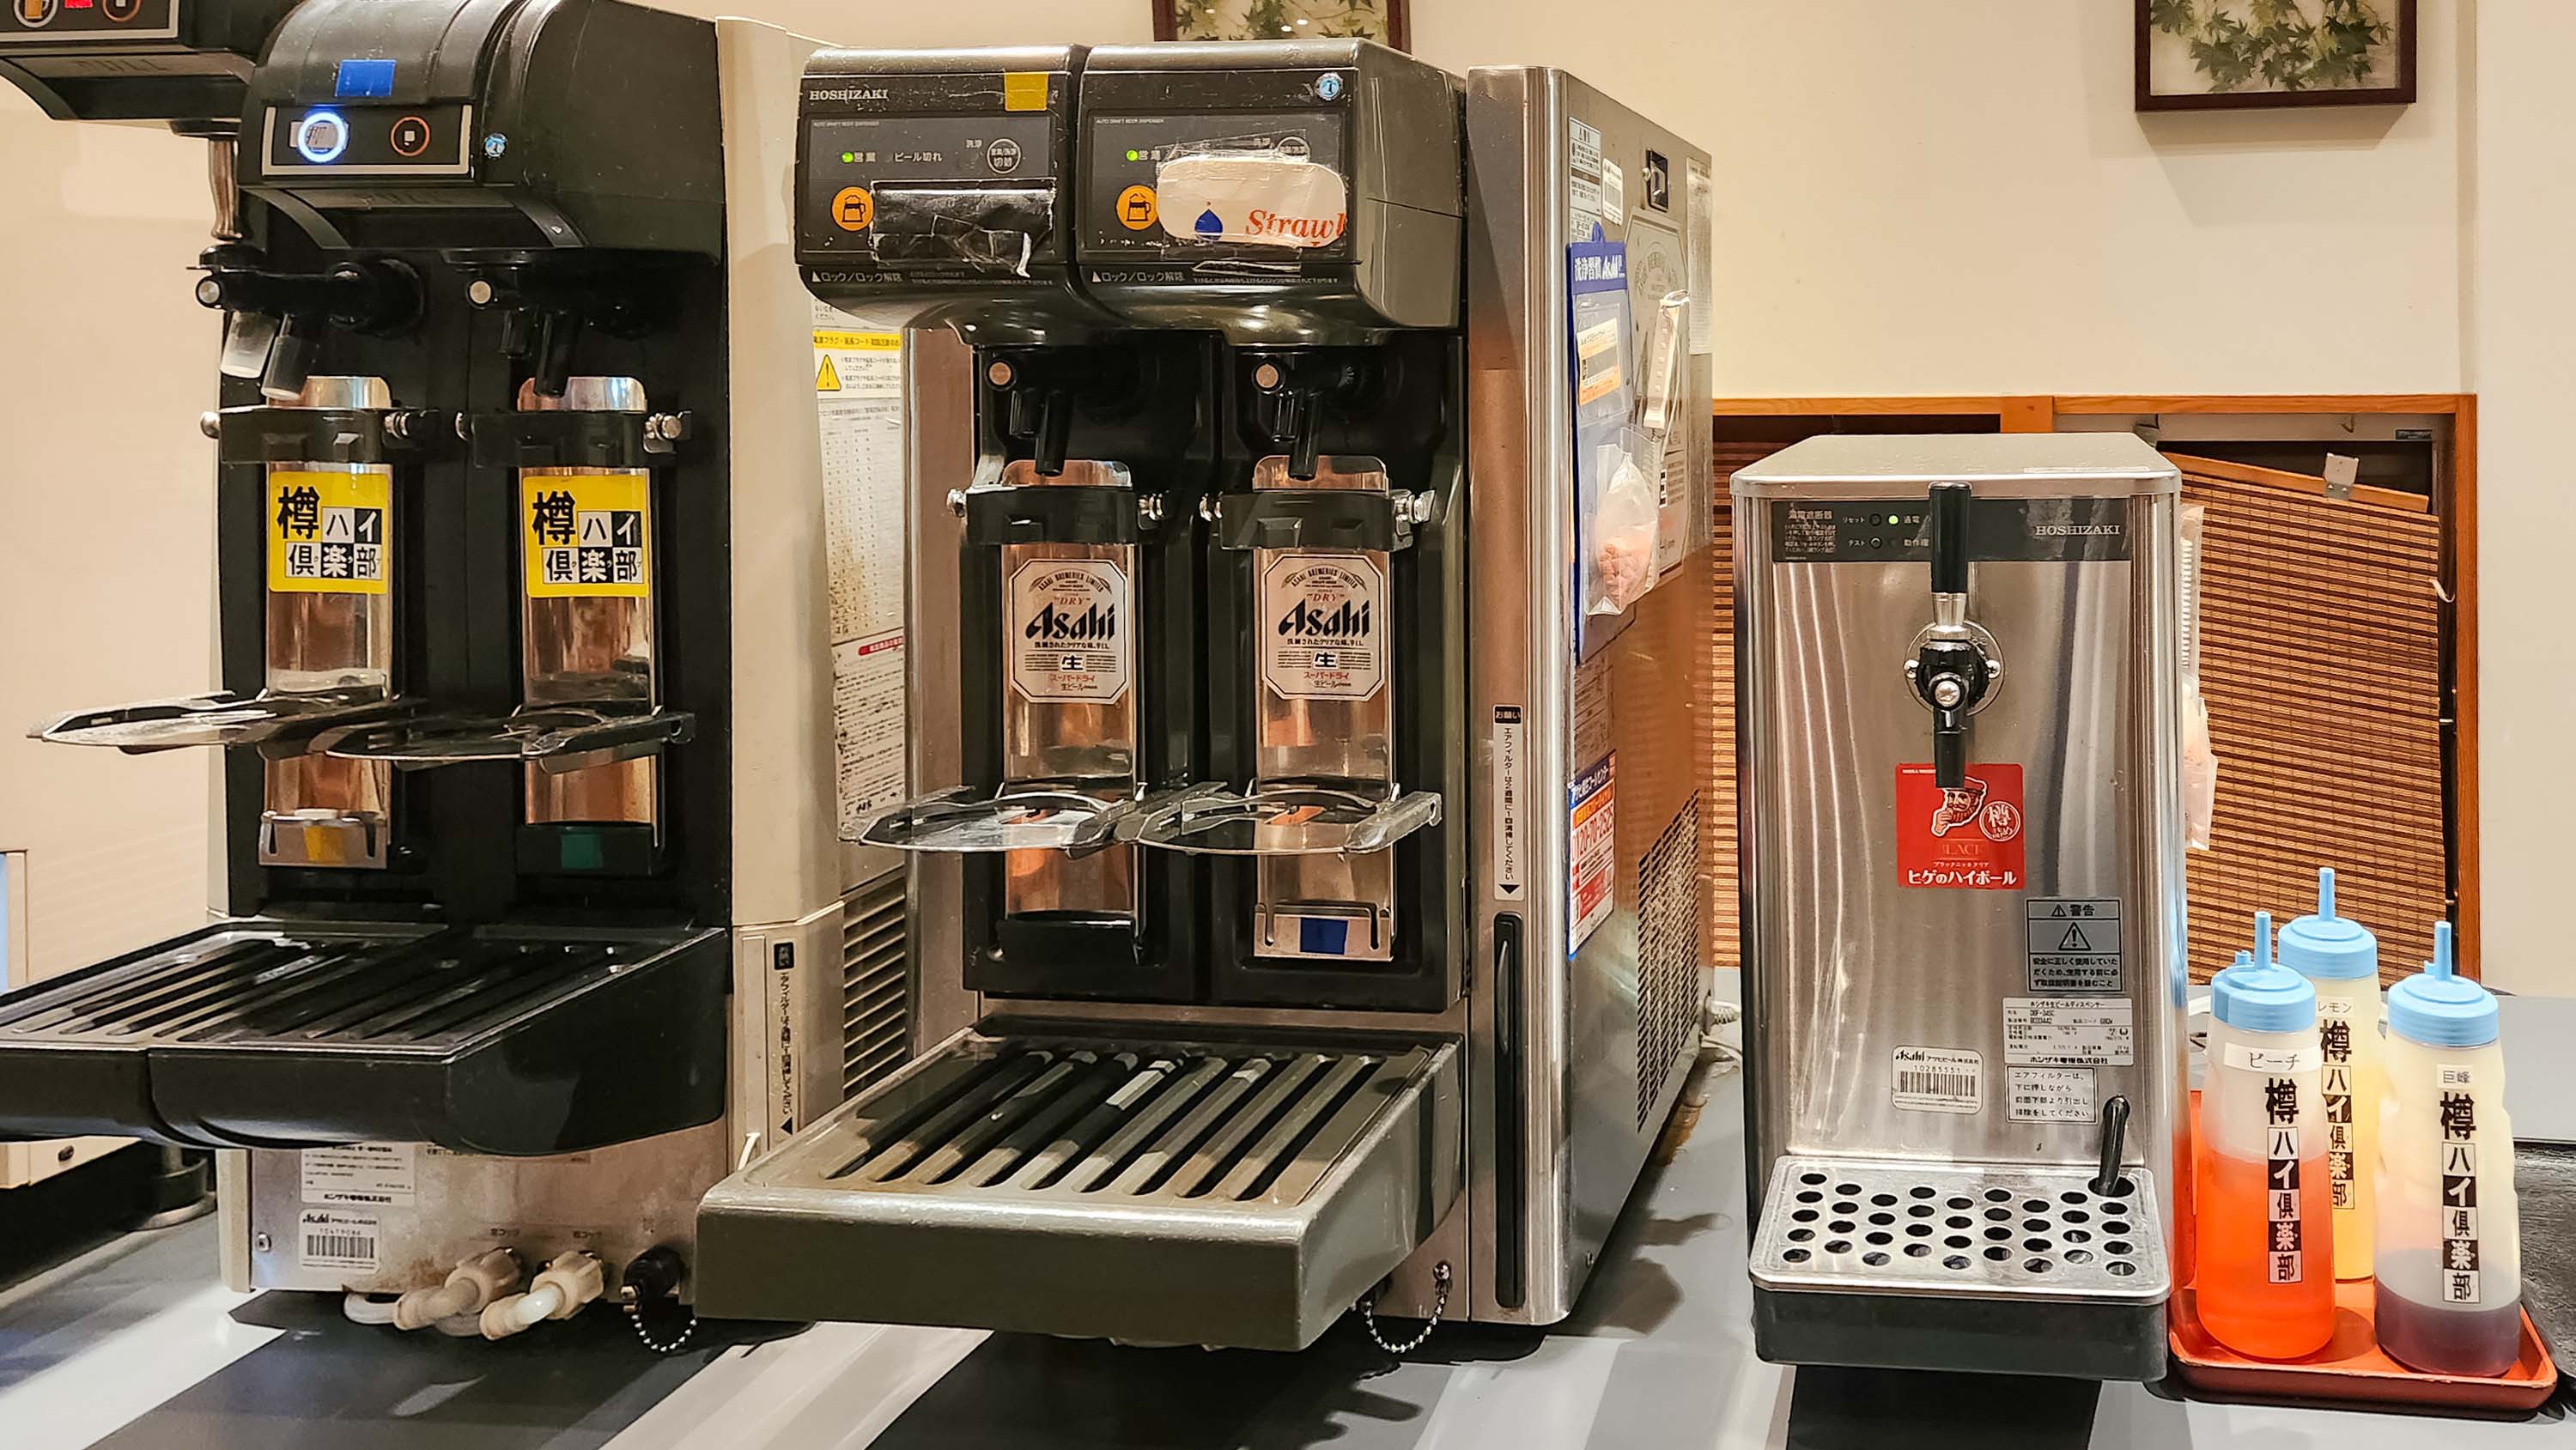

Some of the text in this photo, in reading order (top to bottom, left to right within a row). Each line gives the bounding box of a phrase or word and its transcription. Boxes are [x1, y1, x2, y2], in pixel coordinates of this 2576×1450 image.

[809, 88, 889, 100] HOSHIZAKI
[894, 152, 942, 162] ビール切れ
[276, 486, 379, 541] 樽ハイ
[532, 490, 639, 547] 樽ハイ
[2035, 525, 2120, 536] HOSHIZAKI
[289, 545, 376, 577] 倶楽部
[546, 549, 637, 582] 倶楽部
[1025, 602, 1115, 640] Asahi
[1278, 598, 1370, 638] Asahi
[1061, 655, 1084, 670] 生
[1315, 652, 1337, 668] 生
[1049, 673, 1095, 682] スーパードライ
[1303, 671, 1349, 680] スーパードライ
[1496, 710, 1521, 719] お願い
[1907, 870, 2017, 886] ヒゲのハイボール
[2069, 904, 2095, 916] 警告
[2318, 1001, 2352, 1012] レモン
[1895, 1050, 1925, 1062] Asahi
[2248, 1051, 2301, 1071] ピーチ
[2443, 1071, 2470, 1084] 巨峰
[2264, 1077, 2300, 1282] 樽ハイ倶楽部
[2440, 1091, 2476, 1301] 樽ハイ倶楽部
